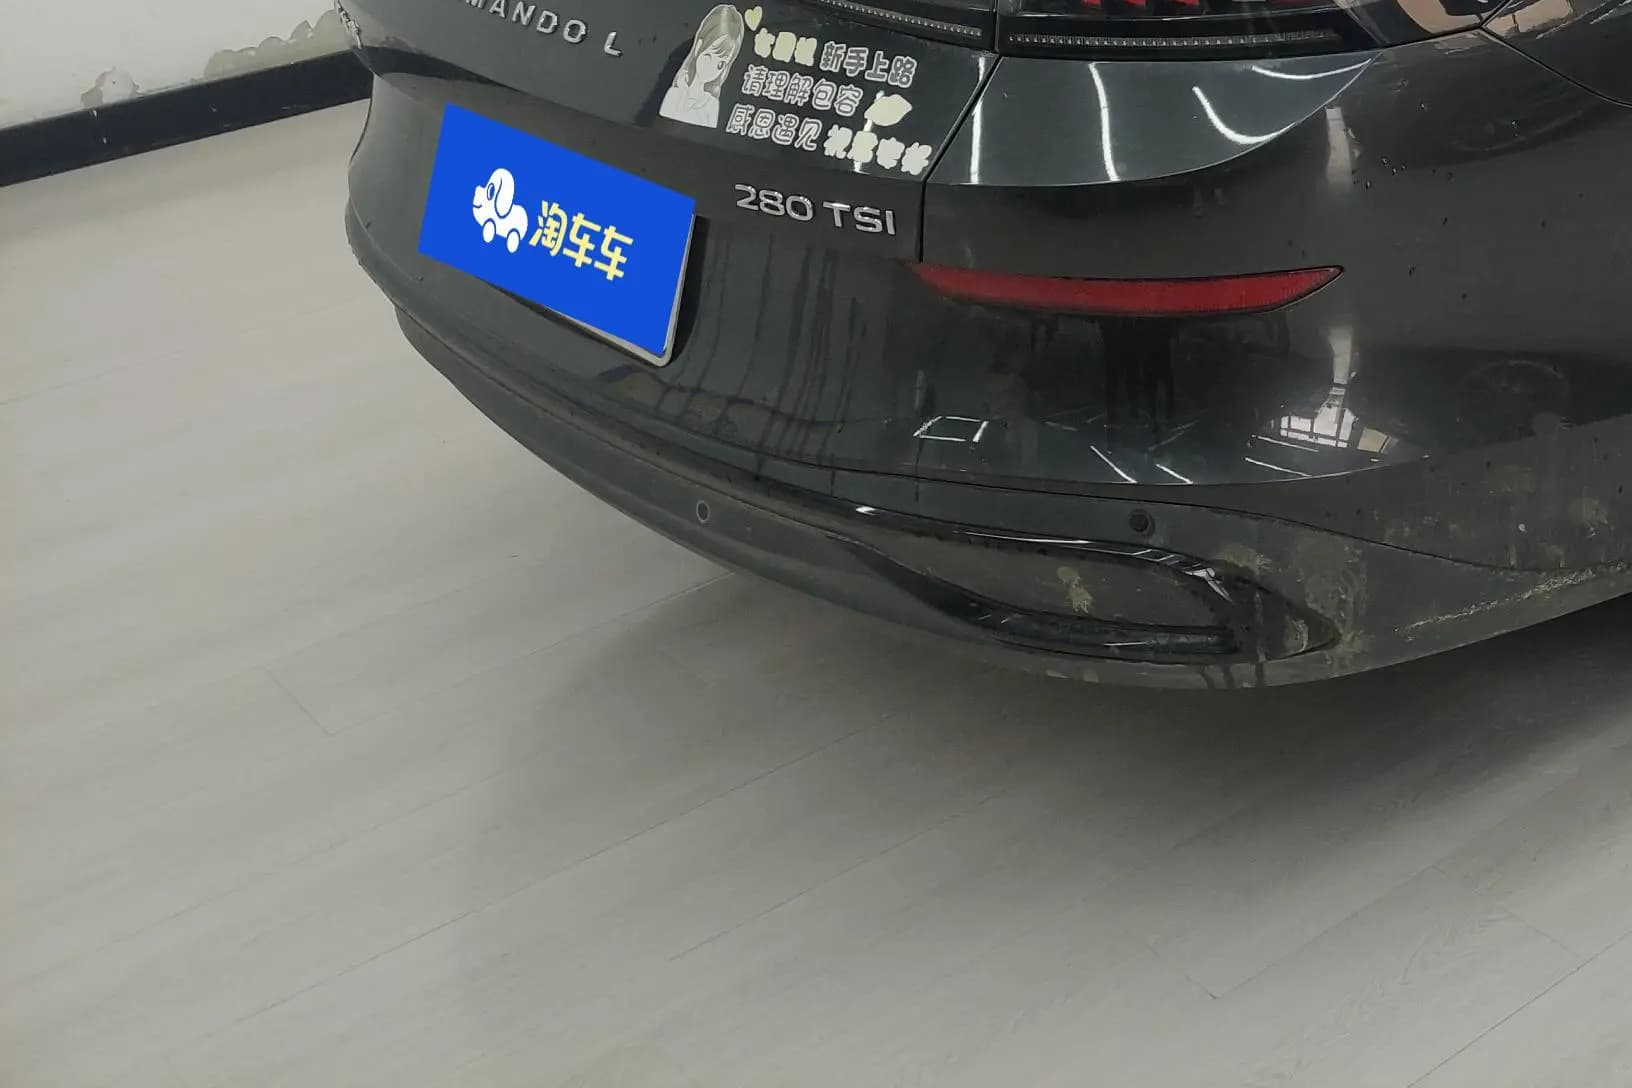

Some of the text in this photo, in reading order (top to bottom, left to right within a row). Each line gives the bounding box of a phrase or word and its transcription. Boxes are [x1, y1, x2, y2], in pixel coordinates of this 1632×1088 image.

[604, 31, 622, 56] L
[819, 40, 918, 88] 新手上路
[741, 64, 863, 117] 请理解包容
[725, 103, 823, 151] 感恩遇见
[735, 184, 895, 235] 280 TSI
